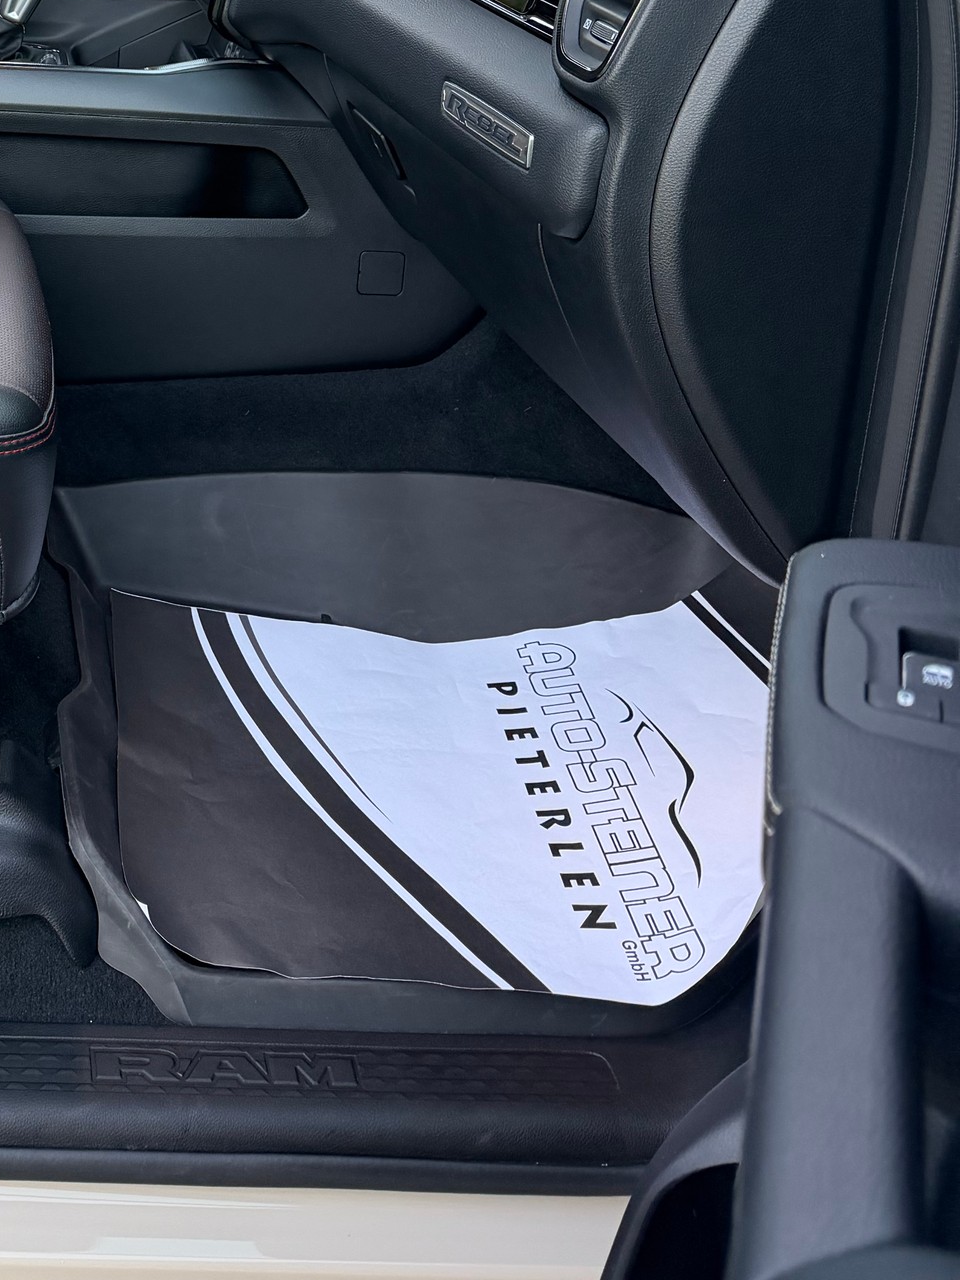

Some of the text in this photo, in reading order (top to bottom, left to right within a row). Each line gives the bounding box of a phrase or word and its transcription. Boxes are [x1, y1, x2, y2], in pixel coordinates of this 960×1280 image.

[446, 92, 523, 158] REBEL
[487, 681, 618, 929] PIETERLEN
[621, 939, 651, 982] GmbH
[89, 1045, 361, 1089] RAM
